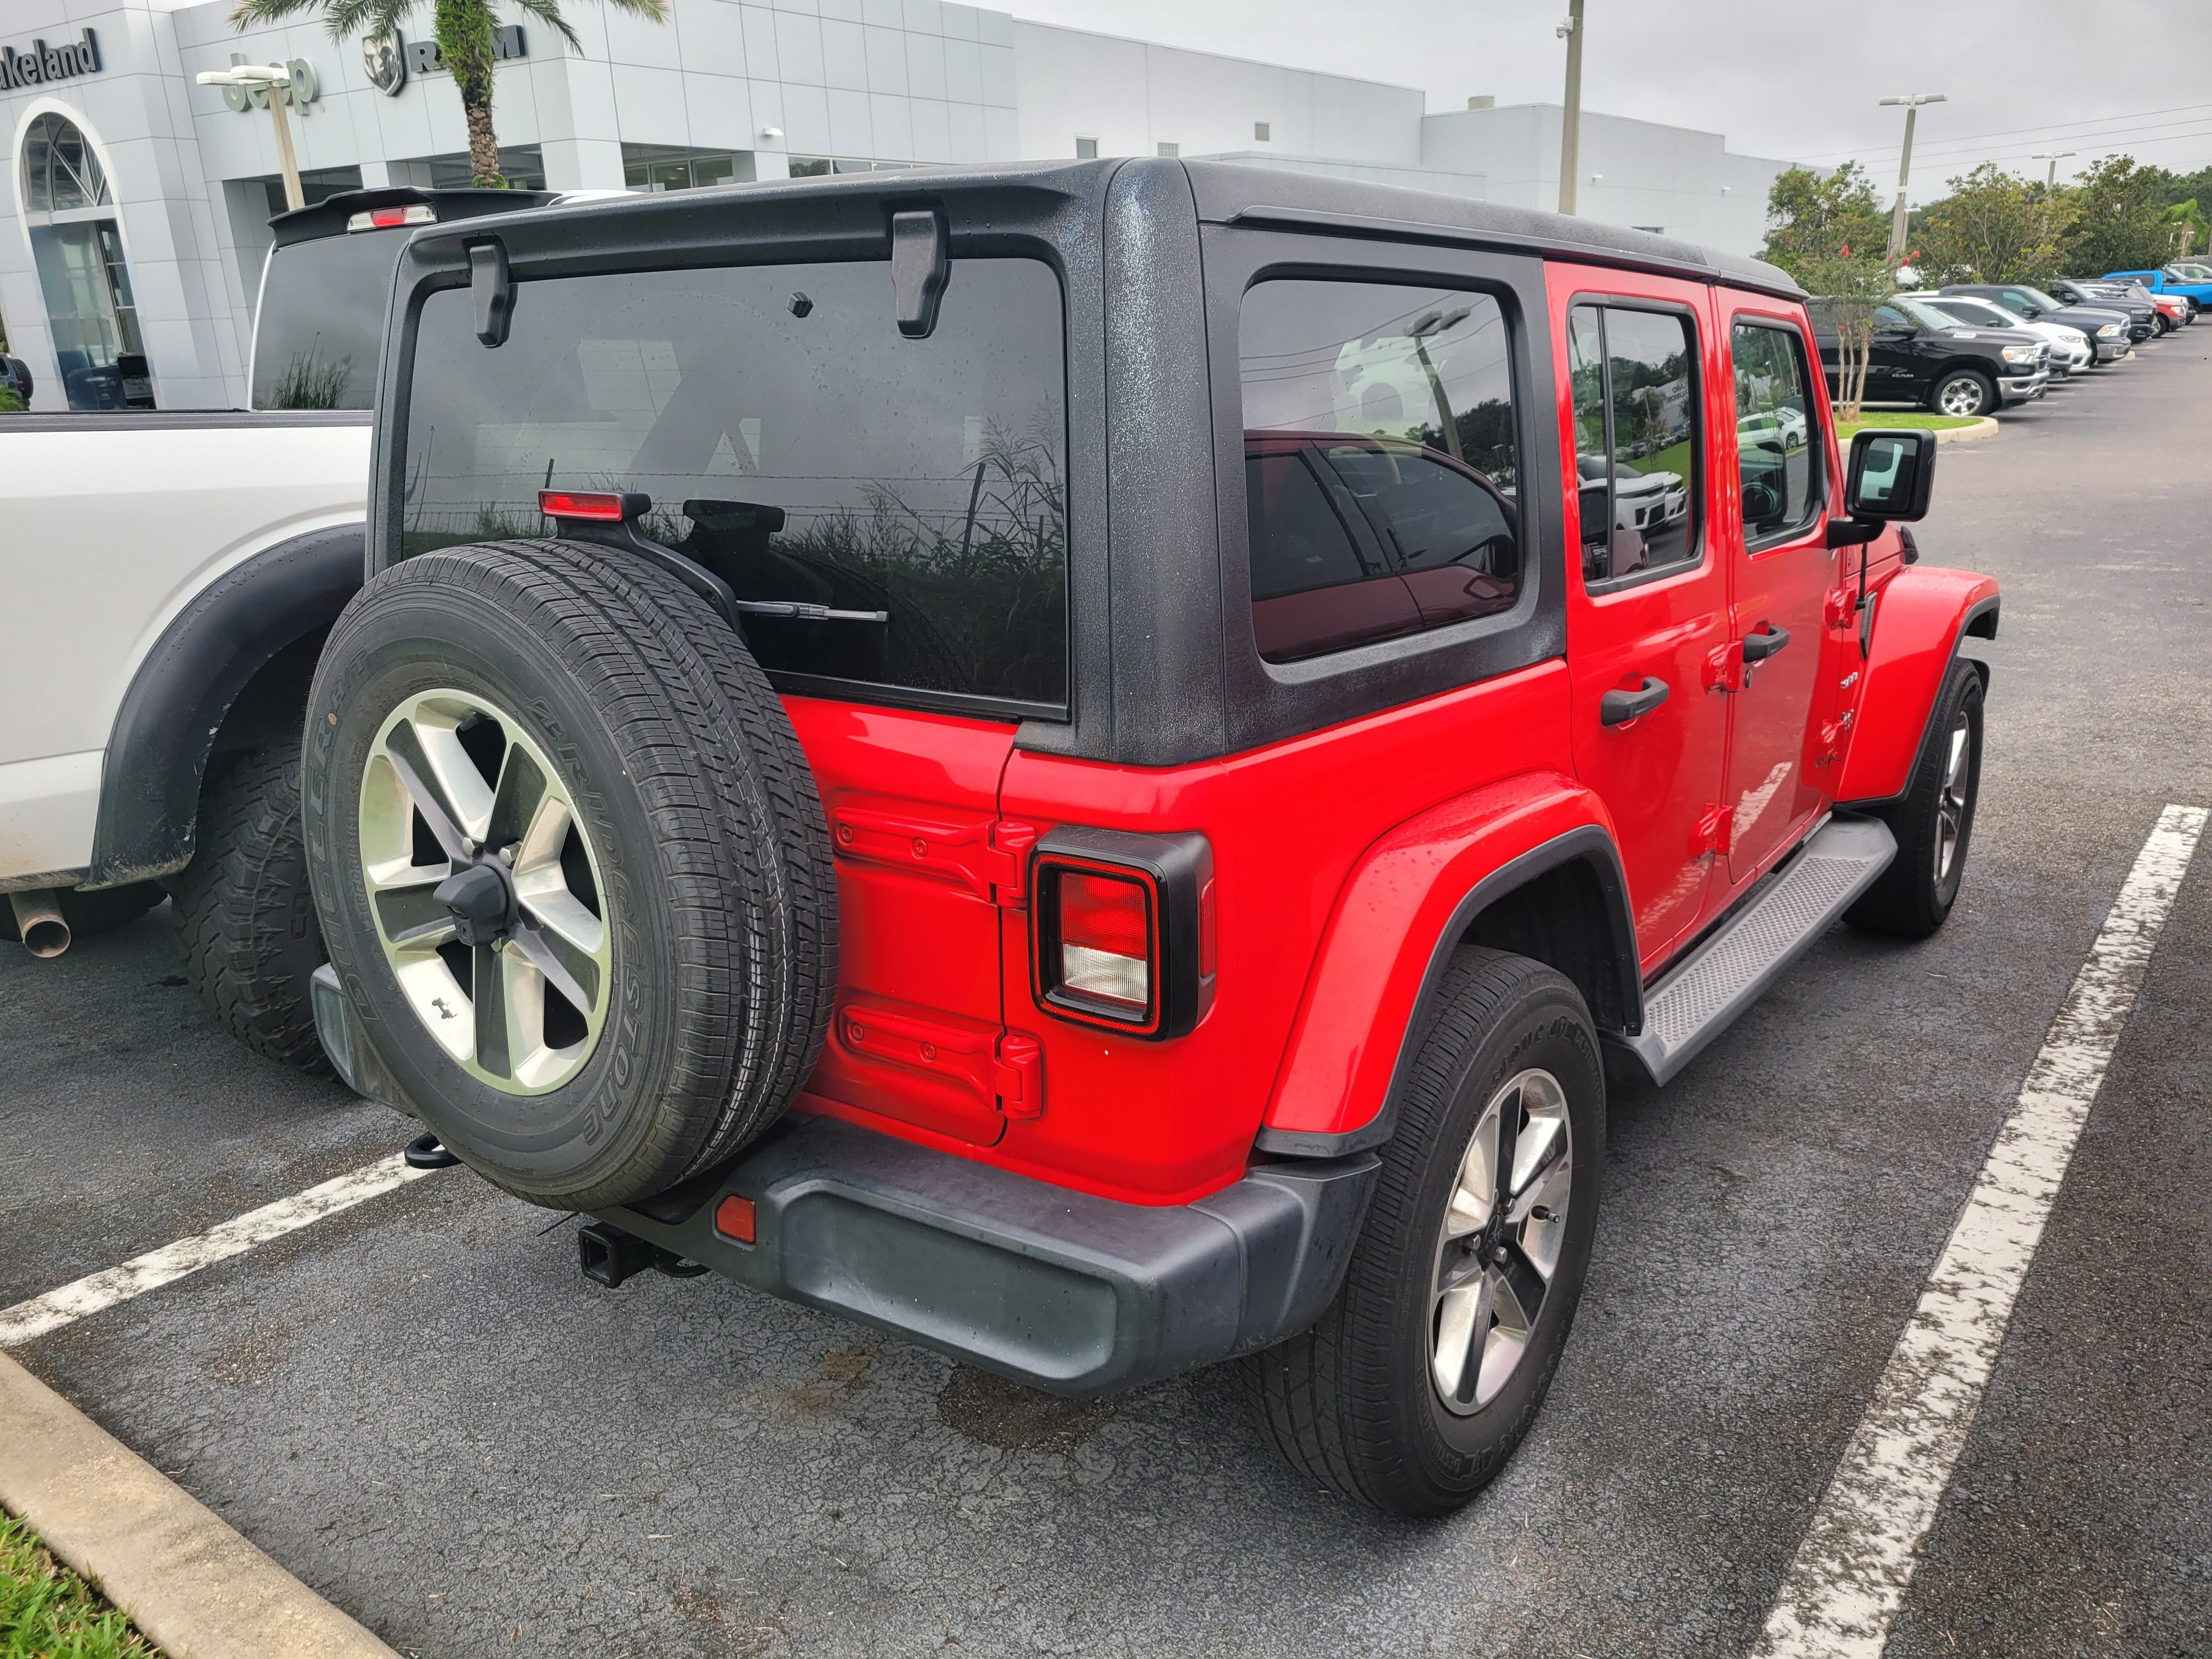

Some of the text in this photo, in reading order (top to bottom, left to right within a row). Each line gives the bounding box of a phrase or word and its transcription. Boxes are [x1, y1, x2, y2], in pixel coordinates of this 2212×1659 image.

[407, 25, 526, 72] RM
[307, 714, 380, 1025] DUELER
[528, 693, 643, 1148] BRIDGESTONE
